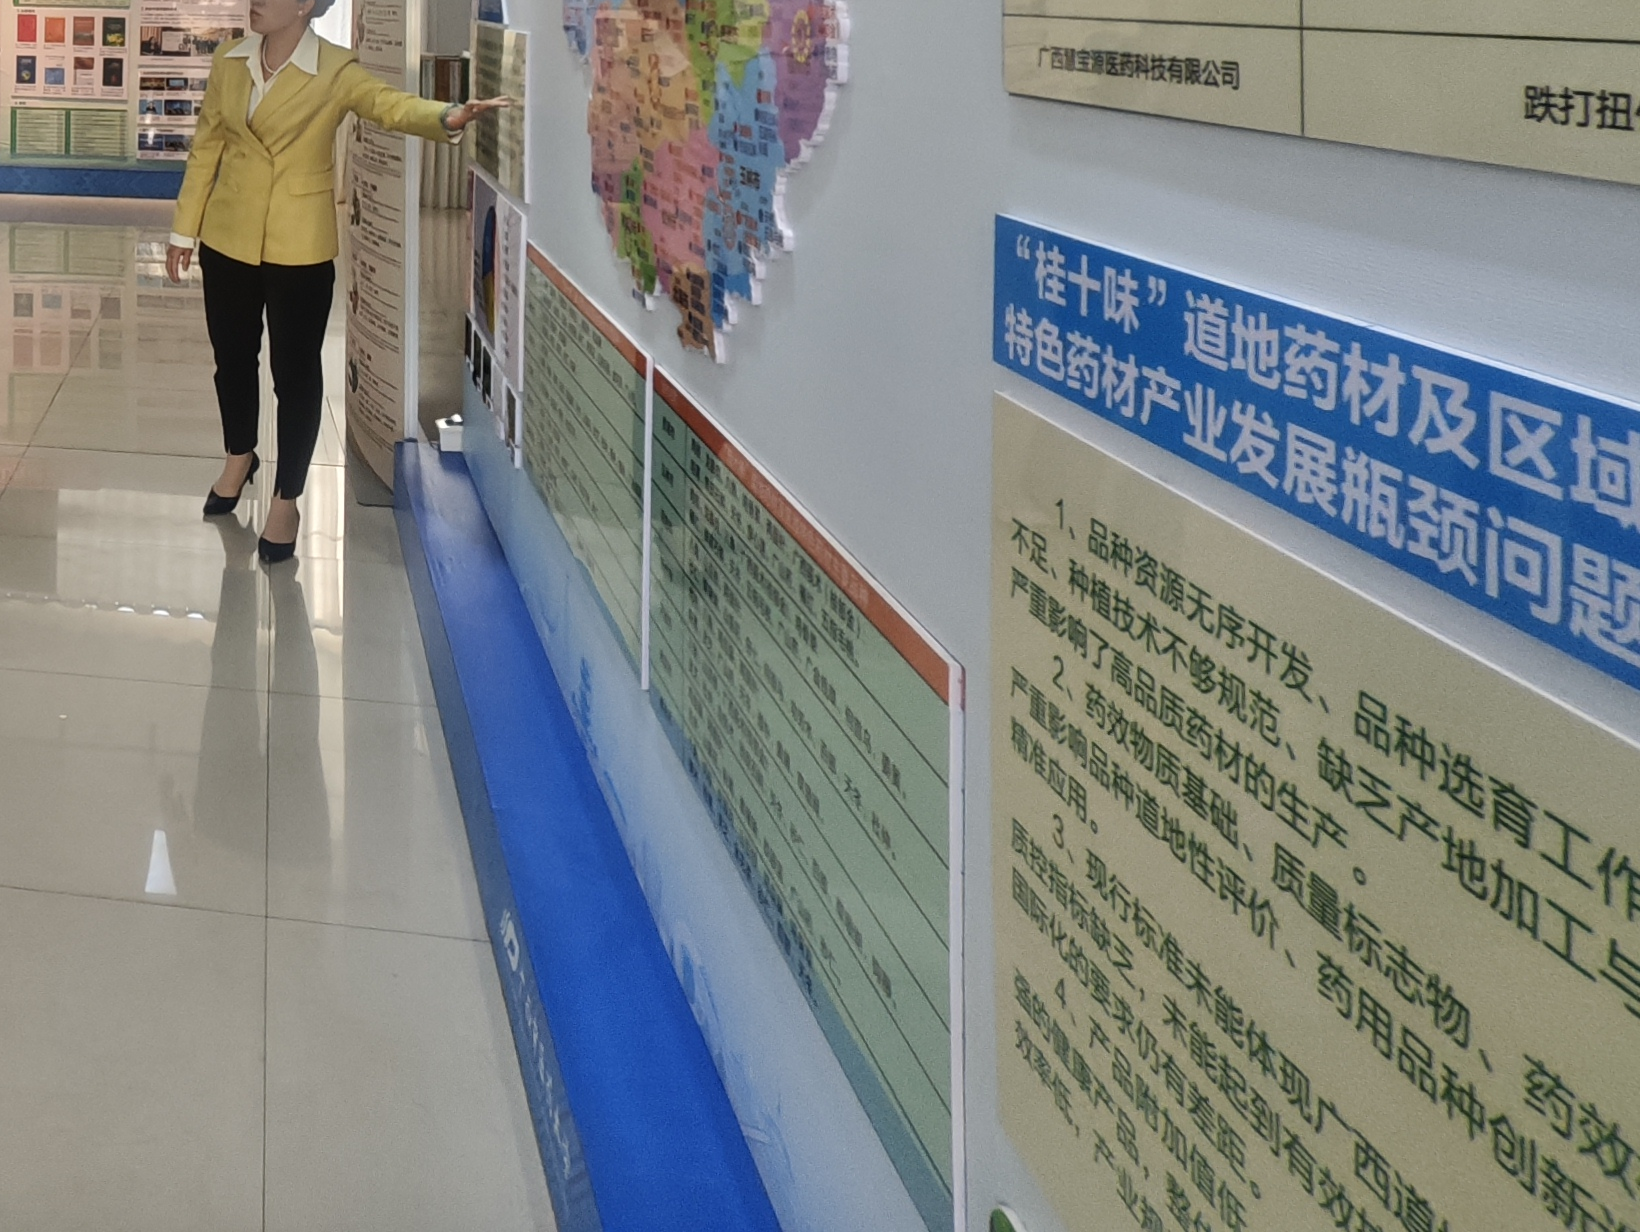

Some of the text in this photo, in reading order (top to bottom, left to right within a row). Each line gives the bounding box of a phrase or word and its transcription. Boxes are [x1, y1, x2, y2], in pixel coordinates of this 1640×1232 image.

[1524, 84, 1640, 131] 跌打扭
[1011, 566, 1367, 887] 严重影响了高品质药材的生产。
[1011, 716, 1098, 834] 精准应用。
[1012, 866, 1261, 1200] 国际化的要求仍有差距。
[1052, 655, 1640, 1201] 2、药效物质基础、质量标志物、药效
[1052, 813, 1451, 1232] 3、现行标准未能体现广西道
